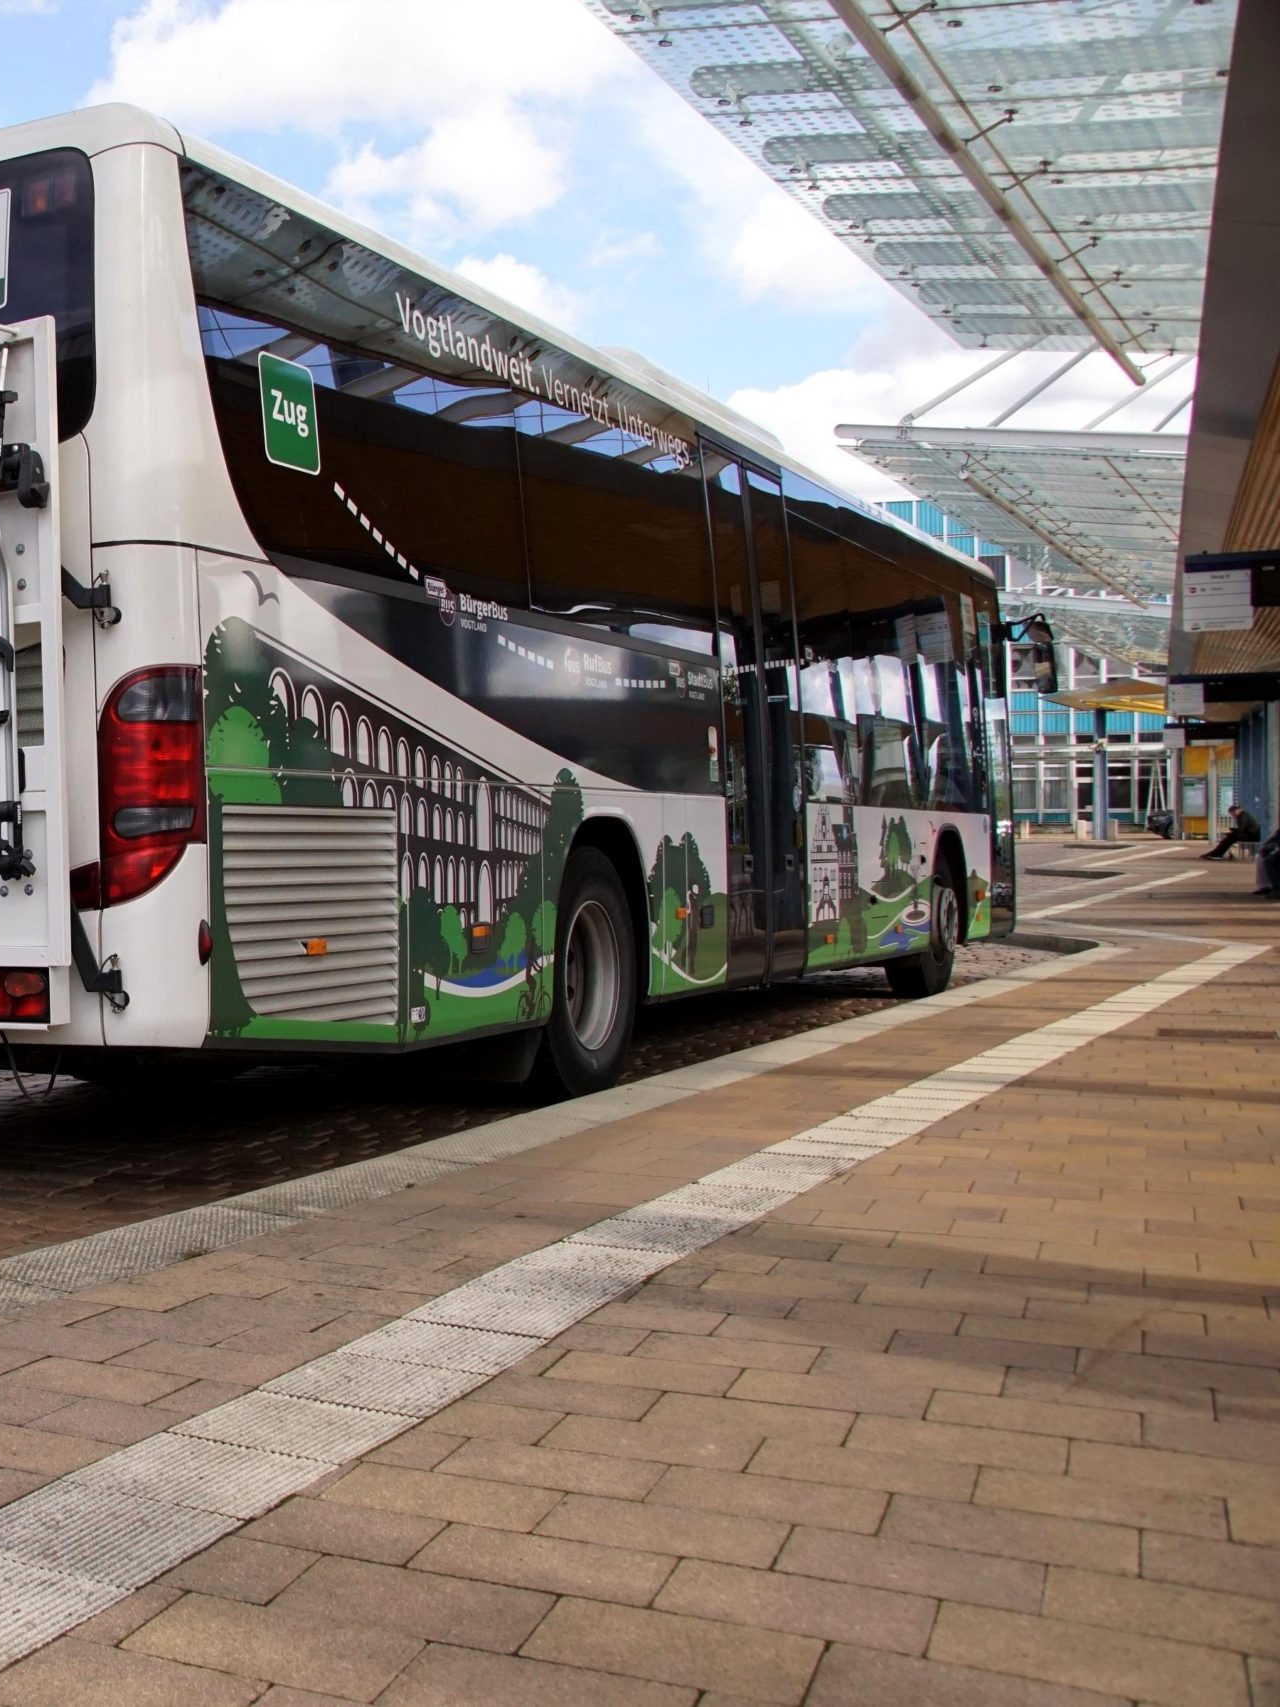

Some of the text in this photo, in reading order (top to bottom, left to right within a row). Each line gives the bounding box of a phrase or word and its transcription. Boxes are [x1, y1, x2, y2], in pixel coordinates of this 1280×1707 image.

[395, 292, 694, 471] Vogtlandweit. Vernetzt. Unterwegs.
[271, 388, 309, 438] Zug
[440, 598, 455, 614] BUS
[459, 593, 508, 621] BürgerBus
[460, 617, 488, 633] VOGTLAND
[583, 652, 613, 675] RufBus
[687, 670, 714, 690] StadtBus
